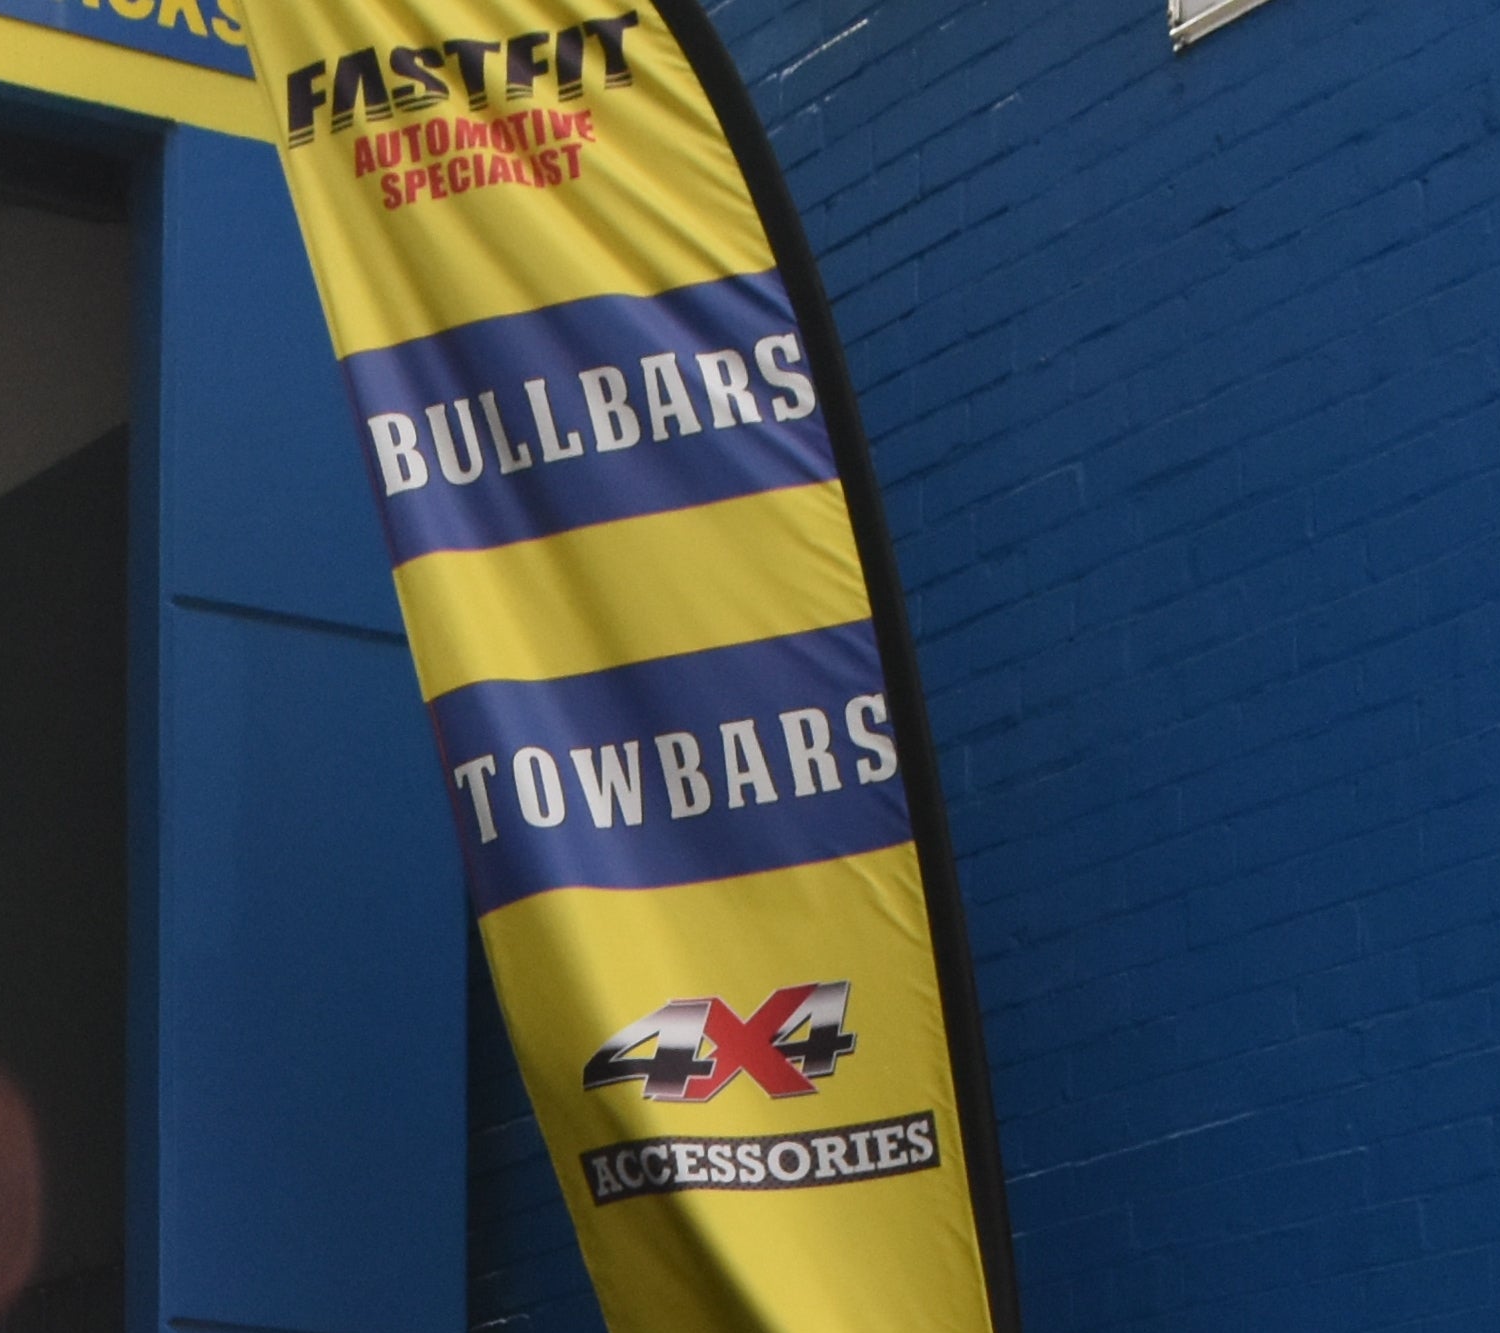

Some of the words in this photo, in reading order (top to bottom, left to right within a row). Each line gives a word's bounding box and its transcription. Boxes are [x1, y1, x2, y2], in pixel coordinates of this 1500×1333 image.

[287, 10, 642, 149] FASTFIT
[353, 107, 596, 179] AUTOMOTIVE
[379, 142, 584, 211] SPECIALIST
[367, 333, 818, 498] BULLBARS
[453, 692, 900, 845] TOWBARS
[581, 979, 859, 1103] 4X4
[594, 1118, 937, 1198] ACCESSORIES
